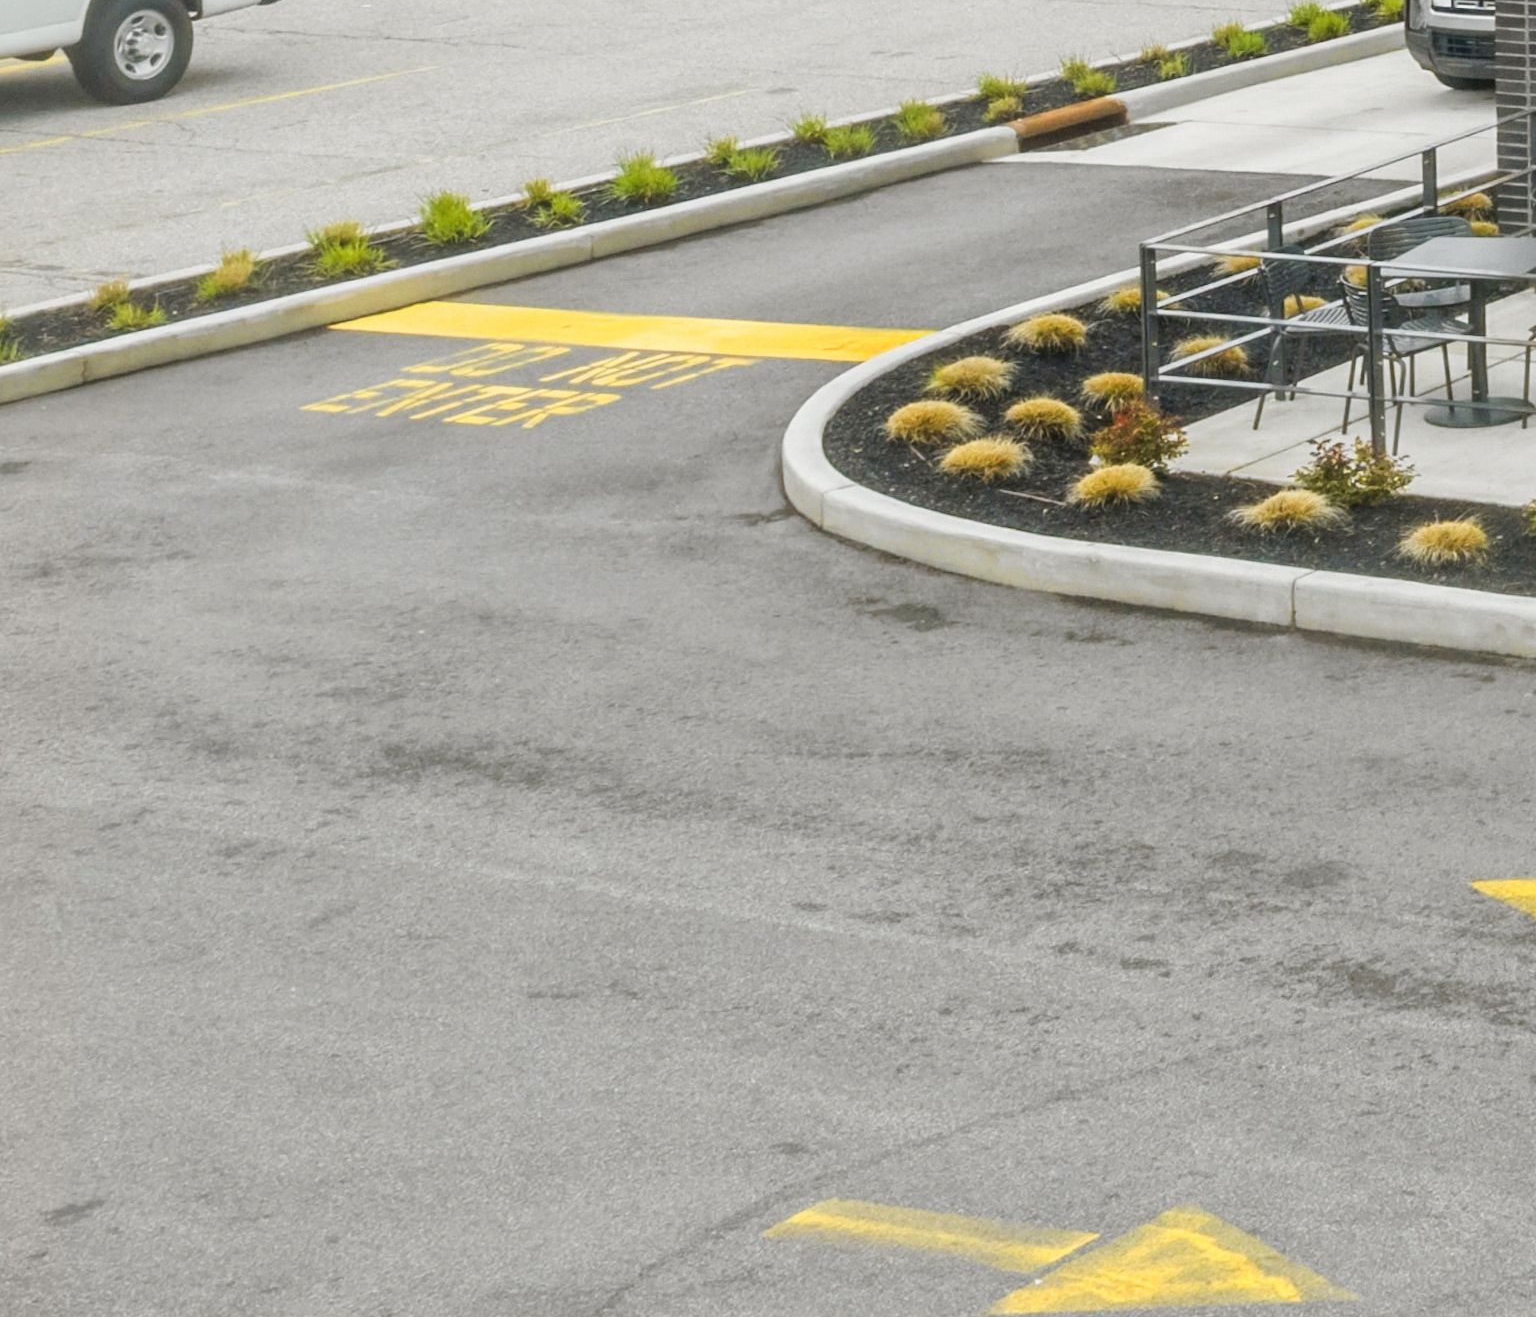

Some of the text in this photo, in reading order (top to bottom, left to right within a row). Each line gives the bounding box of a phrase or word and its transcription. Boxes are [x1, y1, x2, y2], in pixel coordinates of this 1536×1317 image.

[402, 342, 764, 390] DO NOT
[300, 378, 623, 429] ENTER
